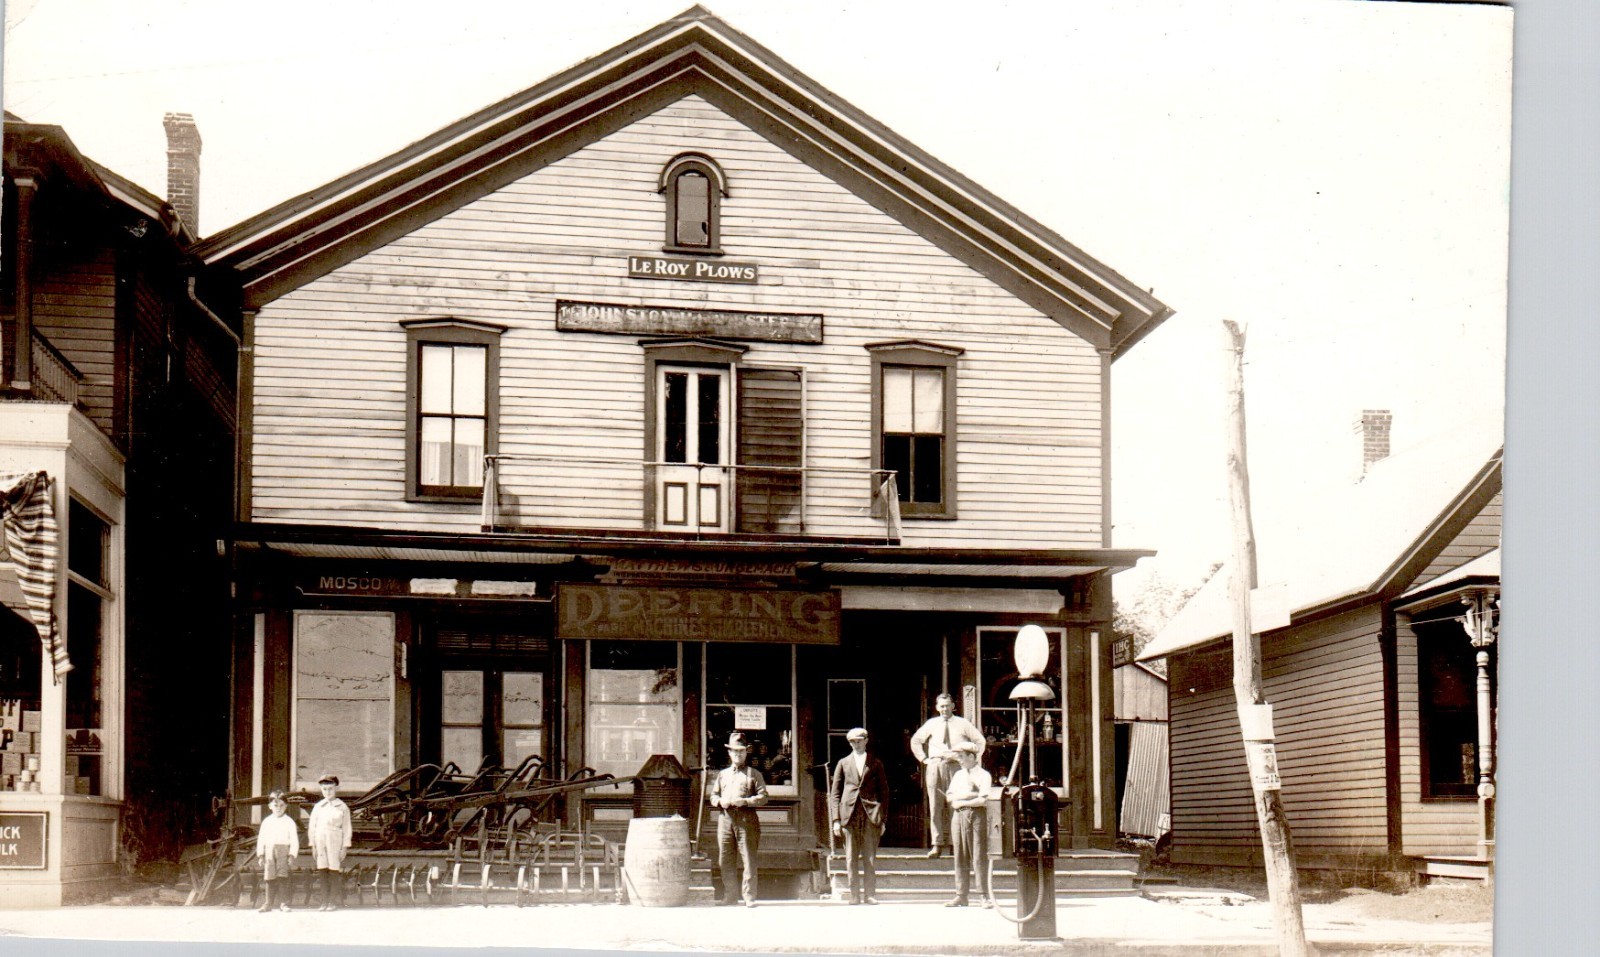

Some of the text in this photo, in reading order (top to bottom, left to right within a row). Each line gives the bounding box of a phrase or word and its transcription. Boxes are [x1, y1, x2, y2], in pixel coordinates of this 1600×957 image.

[695, 262, 755, 280] PLOWS
[562, 587, 835, 630] DEERING
[0, 843, 18, 856] LK
